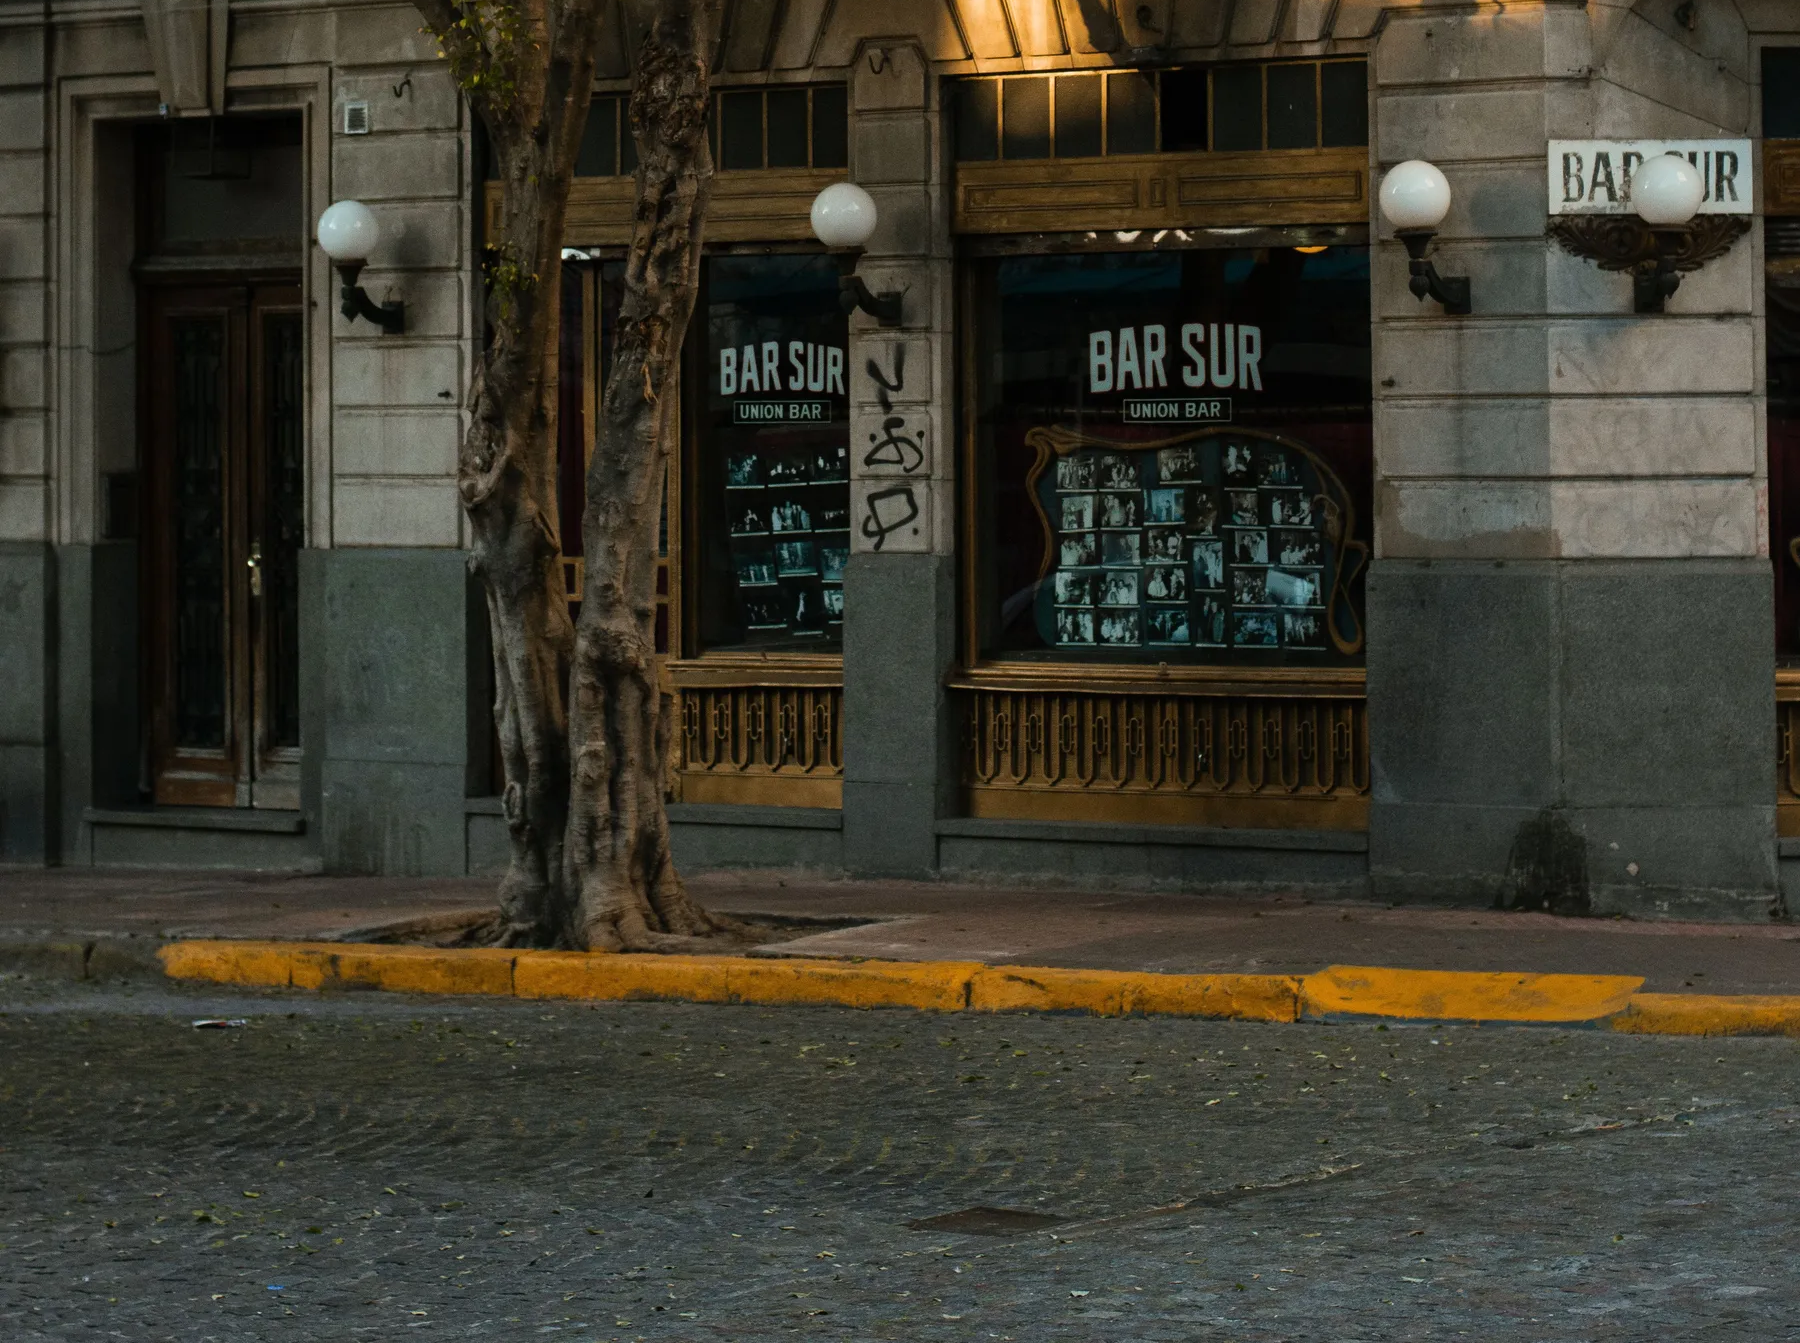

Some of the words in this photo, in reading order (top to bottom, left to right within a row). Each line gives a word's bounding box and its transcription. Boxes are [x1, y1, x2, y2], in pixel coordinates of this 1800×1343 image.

[1664, 150, 1739, 202] UR
[720, 340, 782, 395] BAR
[788, 340, 845, 395] SUR
[1089, 323, 1168, 393] BAR
[1181, 322, 1264, 392] SUR
[739, 403, 784, 419] UNION
[789, 403, 822, 418] BAR
[1130, 402, 1179, 418] UNION
[1185, 401, 1221, 418] BAR
